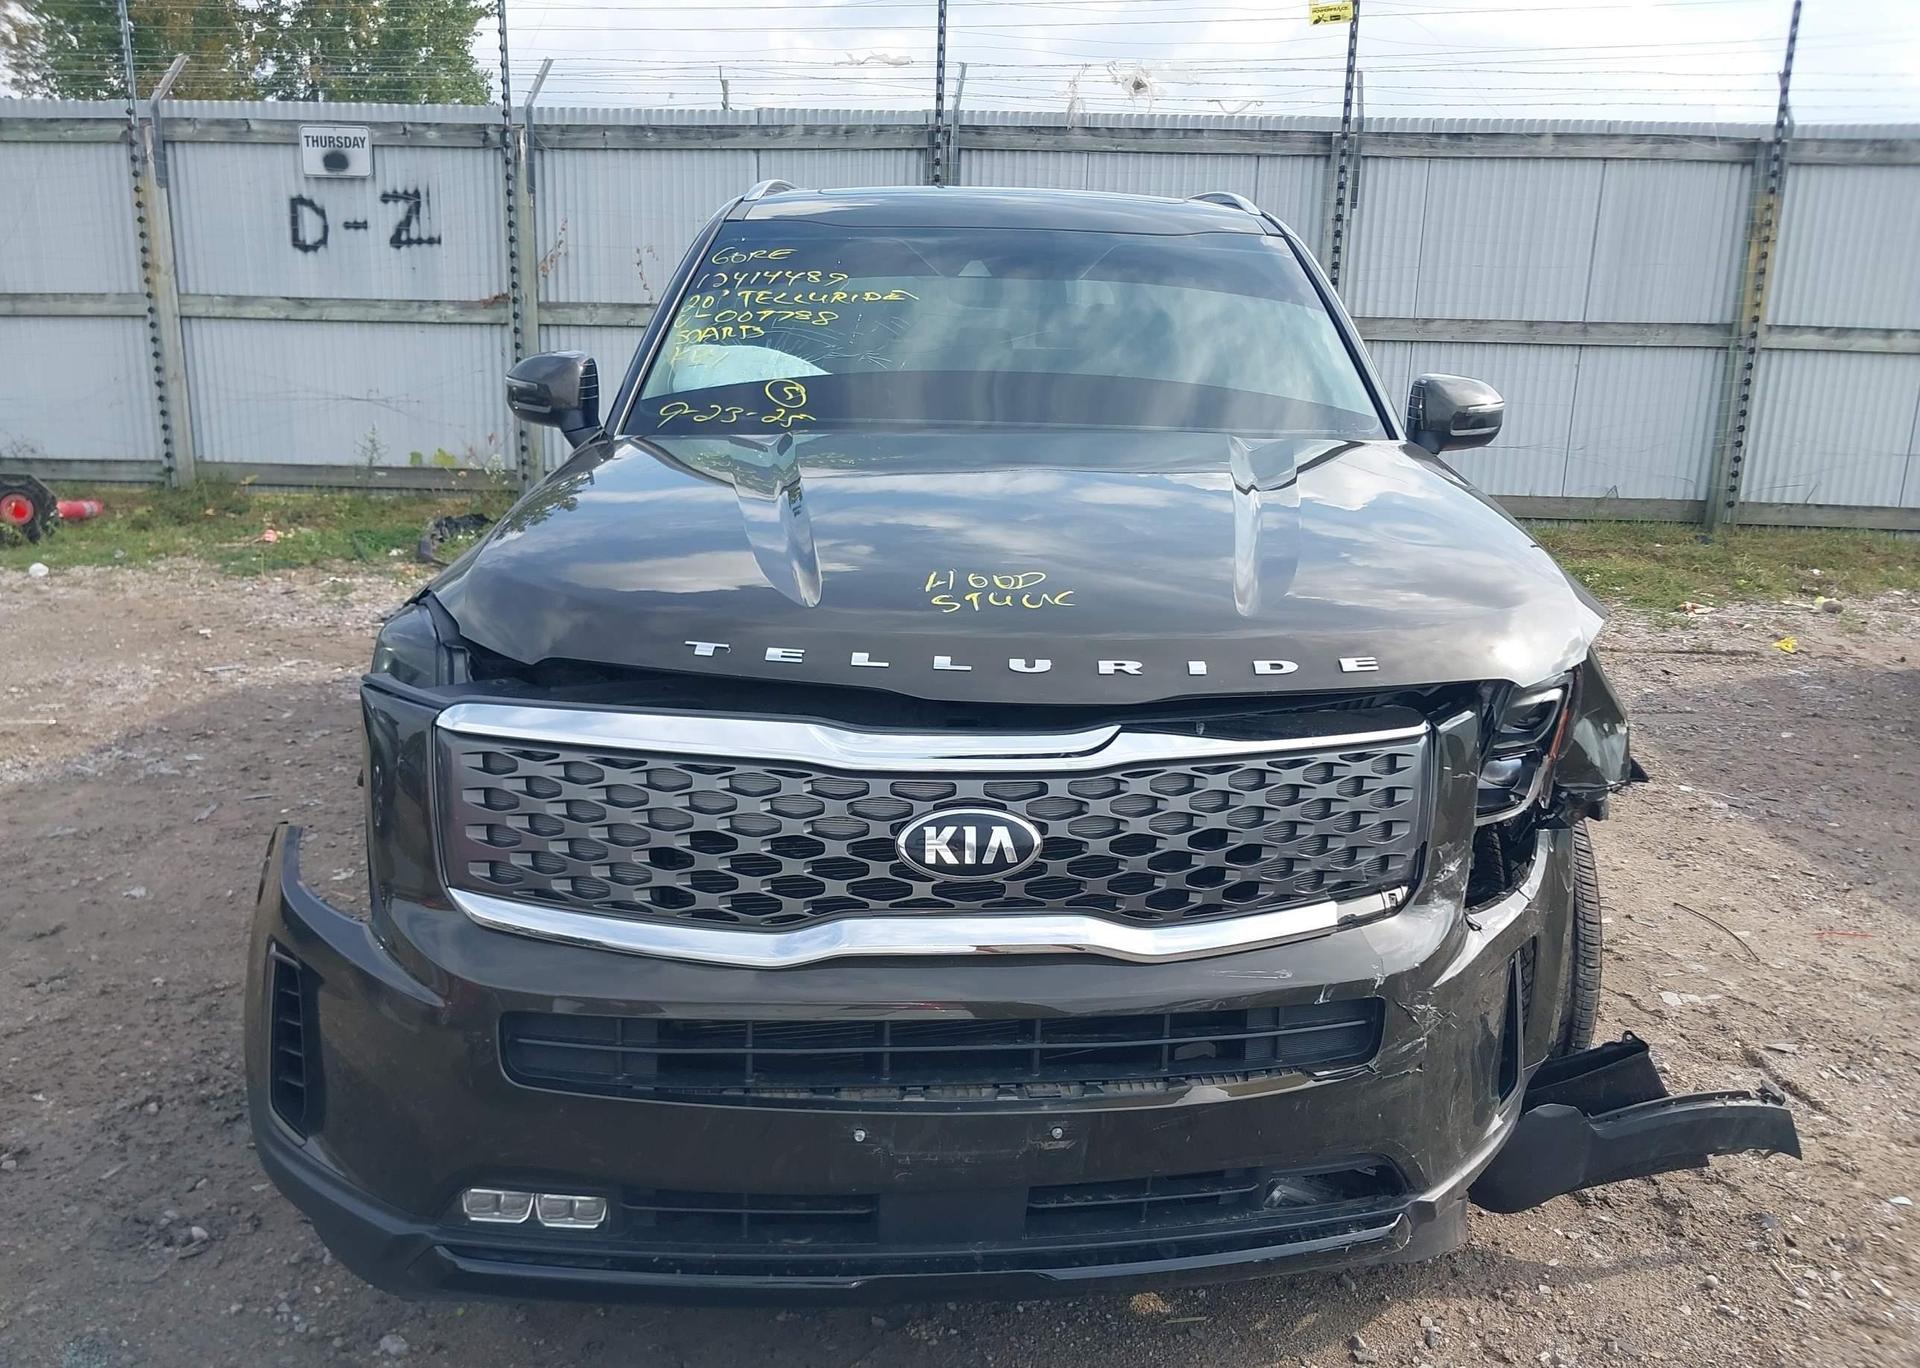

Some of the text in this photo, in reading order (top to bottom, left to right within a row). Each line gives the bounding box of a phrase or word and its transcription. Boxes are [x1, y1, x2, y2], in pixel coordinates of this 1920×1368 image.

[304, 135, 366, 149] THURSDAY
[738, 289, 920, 307] TELLURIDE
[924, 568, 1047, 592] HOOD
[684, 640, 1381, 676] TELLURIDE
[924, 825, 1018, 865] KIA
